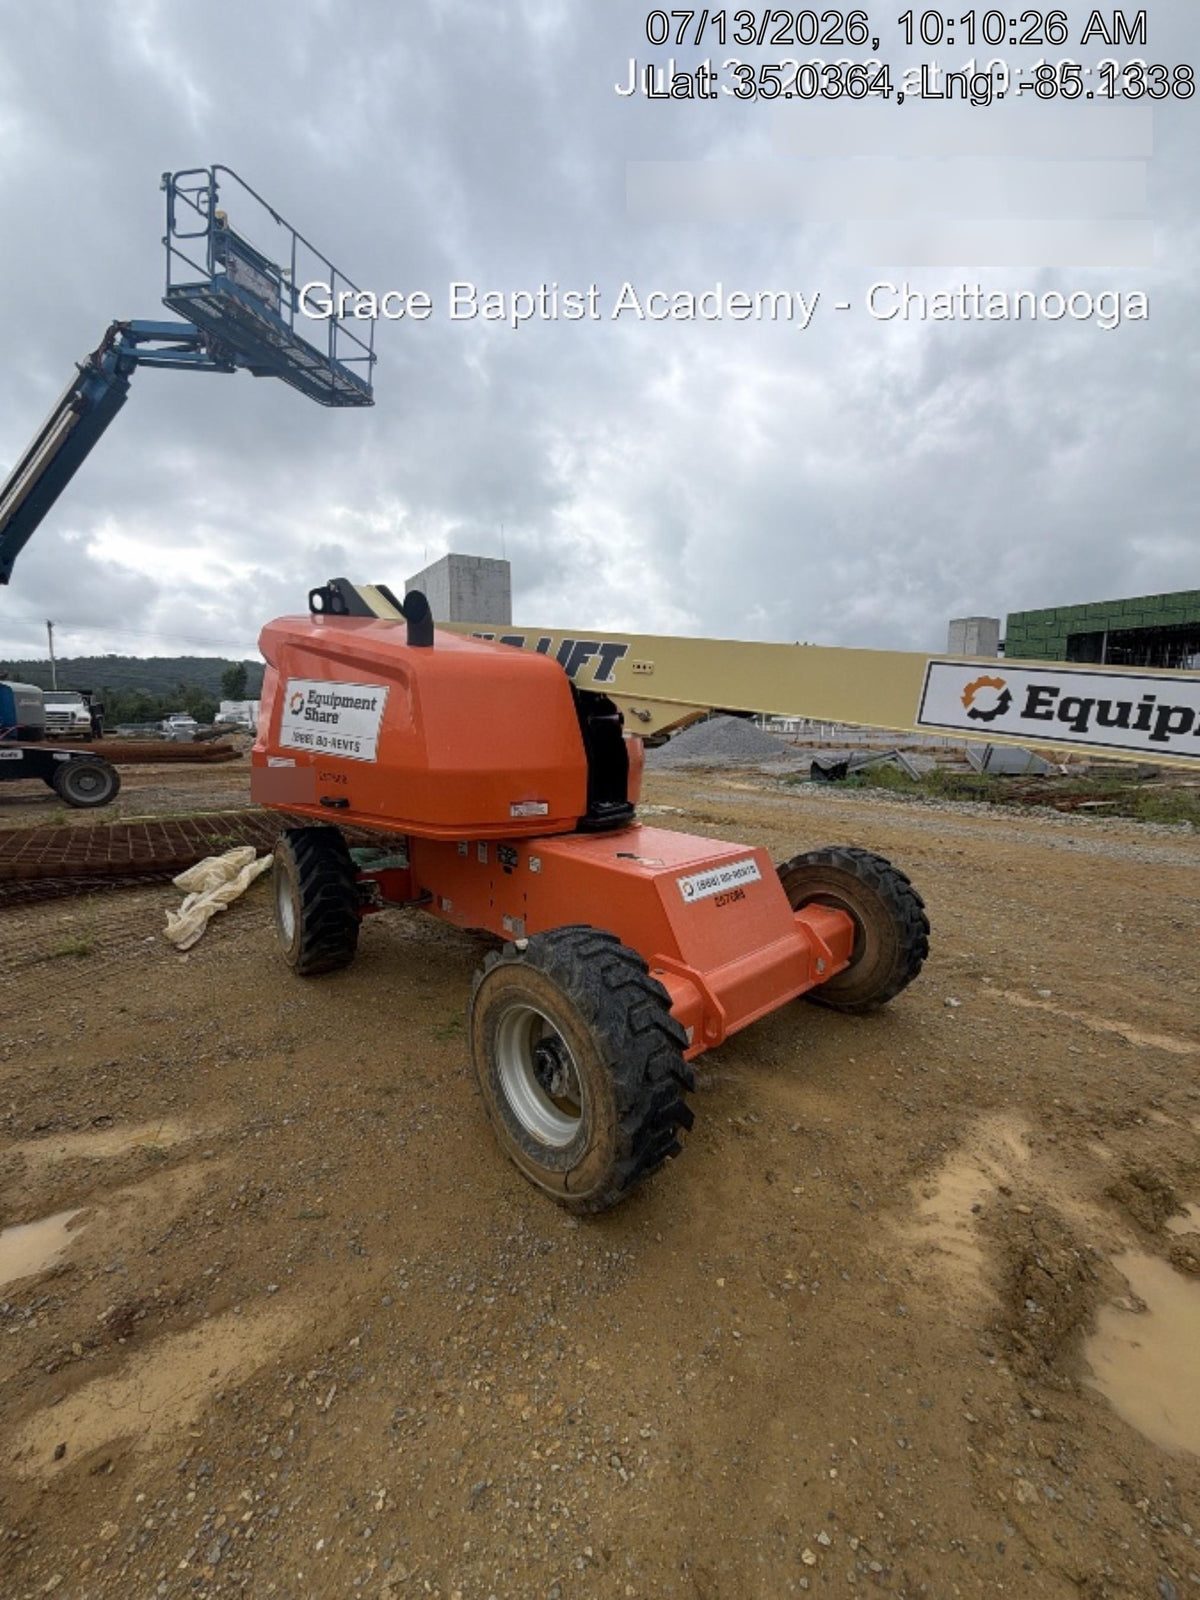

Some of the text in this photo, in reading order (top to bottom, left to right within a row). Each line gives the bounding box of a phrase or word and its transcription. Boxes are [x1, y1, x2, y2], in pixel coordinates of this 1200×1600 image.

[307, 689, 378, 712] Equipment
[304, 707, 340, 725] Share
[1020, 683, 1200, 742] Equip
